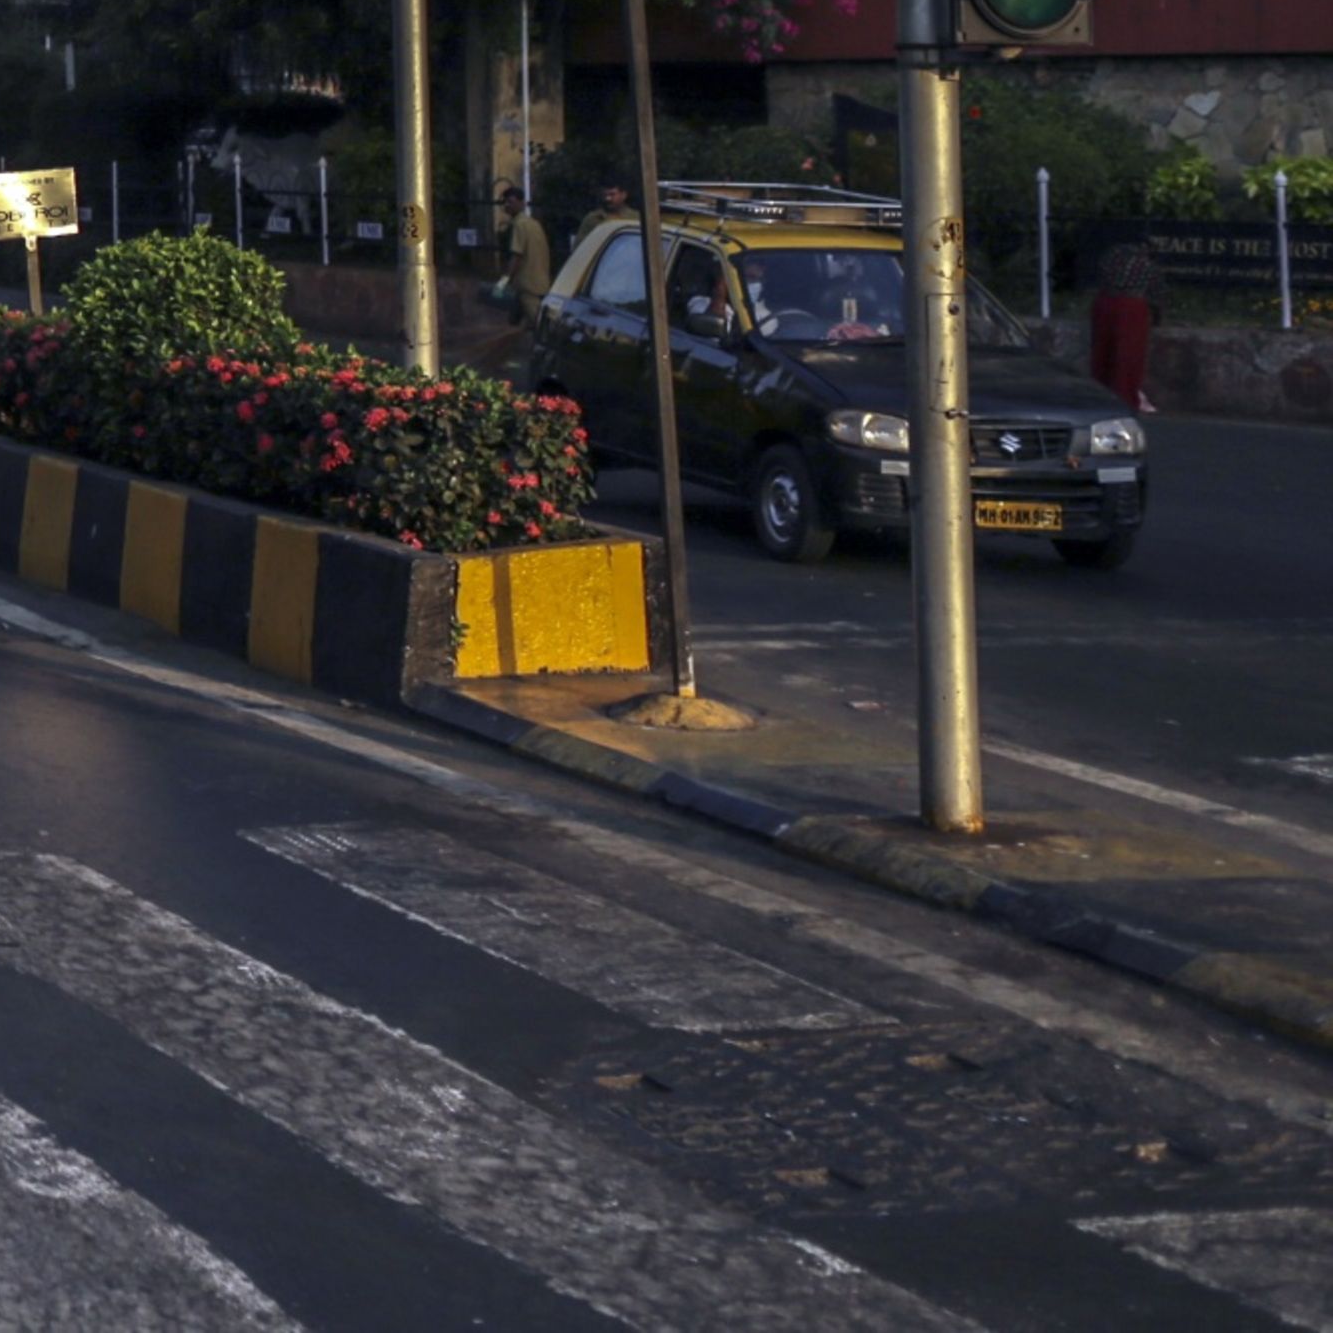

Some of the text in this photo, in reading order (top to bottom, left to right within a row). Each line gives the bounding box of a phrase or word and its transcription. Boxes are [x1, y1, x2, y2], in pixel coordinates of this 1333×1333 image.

[1210, 237, 1226, 255] IS
[1234, 239, 1271, 257] THE
[1288, 240, 1331, 260] OST
